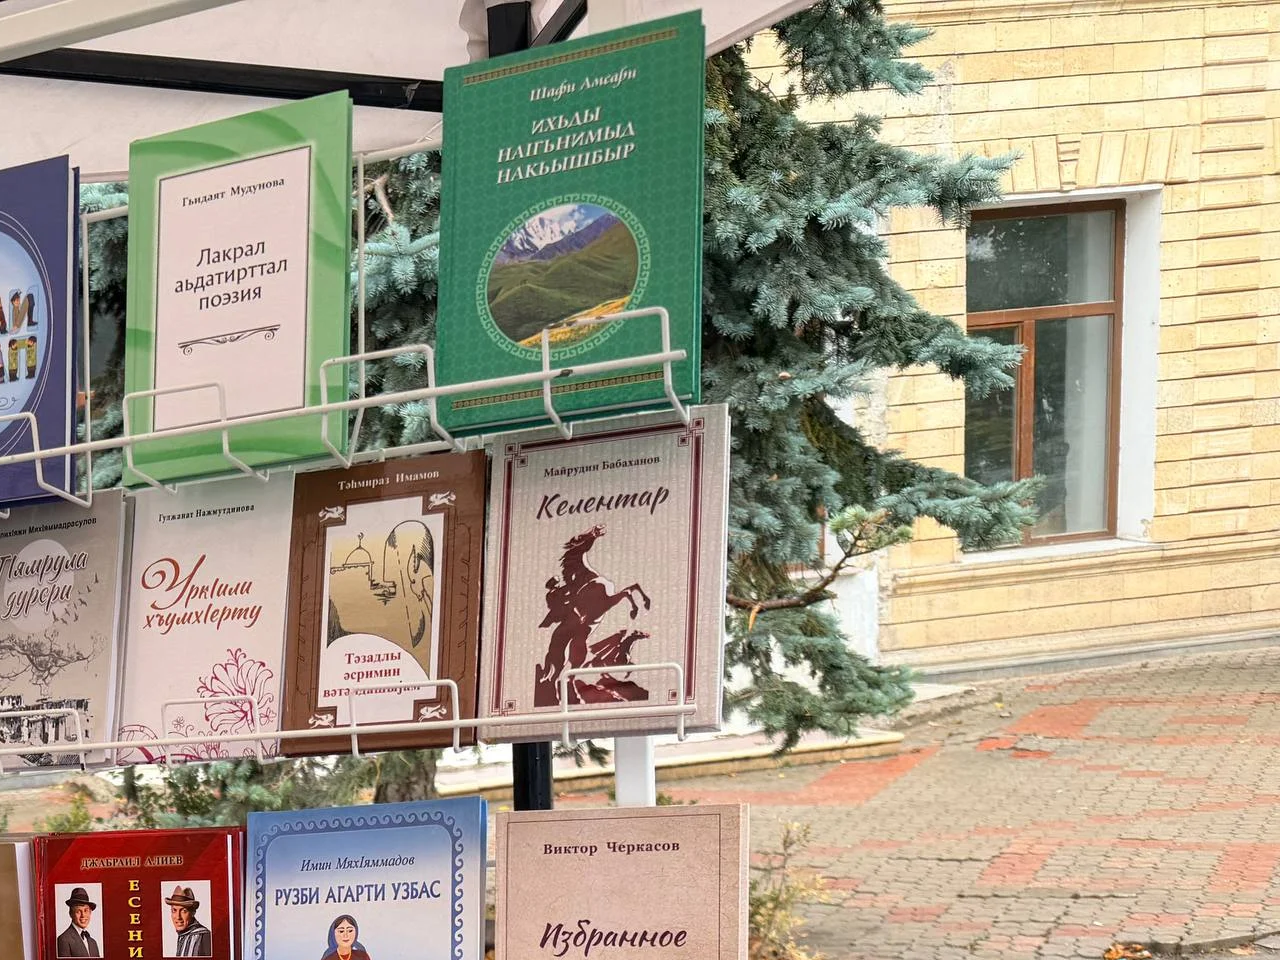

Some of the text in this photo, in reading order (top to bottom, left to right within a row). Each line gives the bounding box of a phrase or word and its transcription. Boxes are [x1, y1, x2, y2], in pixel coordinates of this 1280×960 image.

[530, 80, 575, 101] Шафи
[531, 106, 601, 135] ИХЬДЫ
[230, 178, 285, 197] Мудунова
[196, 241, 265, 267] Лакрал
[174, 258, 288, 293] аьдатирттал
[199, 286, 262, 310] поэзия
[396, 469, 440, 484] Имамов
[543, 456, 660, 478] Майрудин Бабаханов
[195, 504, 255, 518] Нажмутдинова
[536, 486, 670, 520] Келентар
[543, 841, 680, 856] Виктор Черкасов
[80, 855, 183, 870] ДЖАБРАИЛ АЛИЕВ
[300, 859, 332, 872] Имин
[275, 880, 441, 906] РУЗБИ АГАРТИ УЗБАС
[539, 919, 687, 957] Избранное
